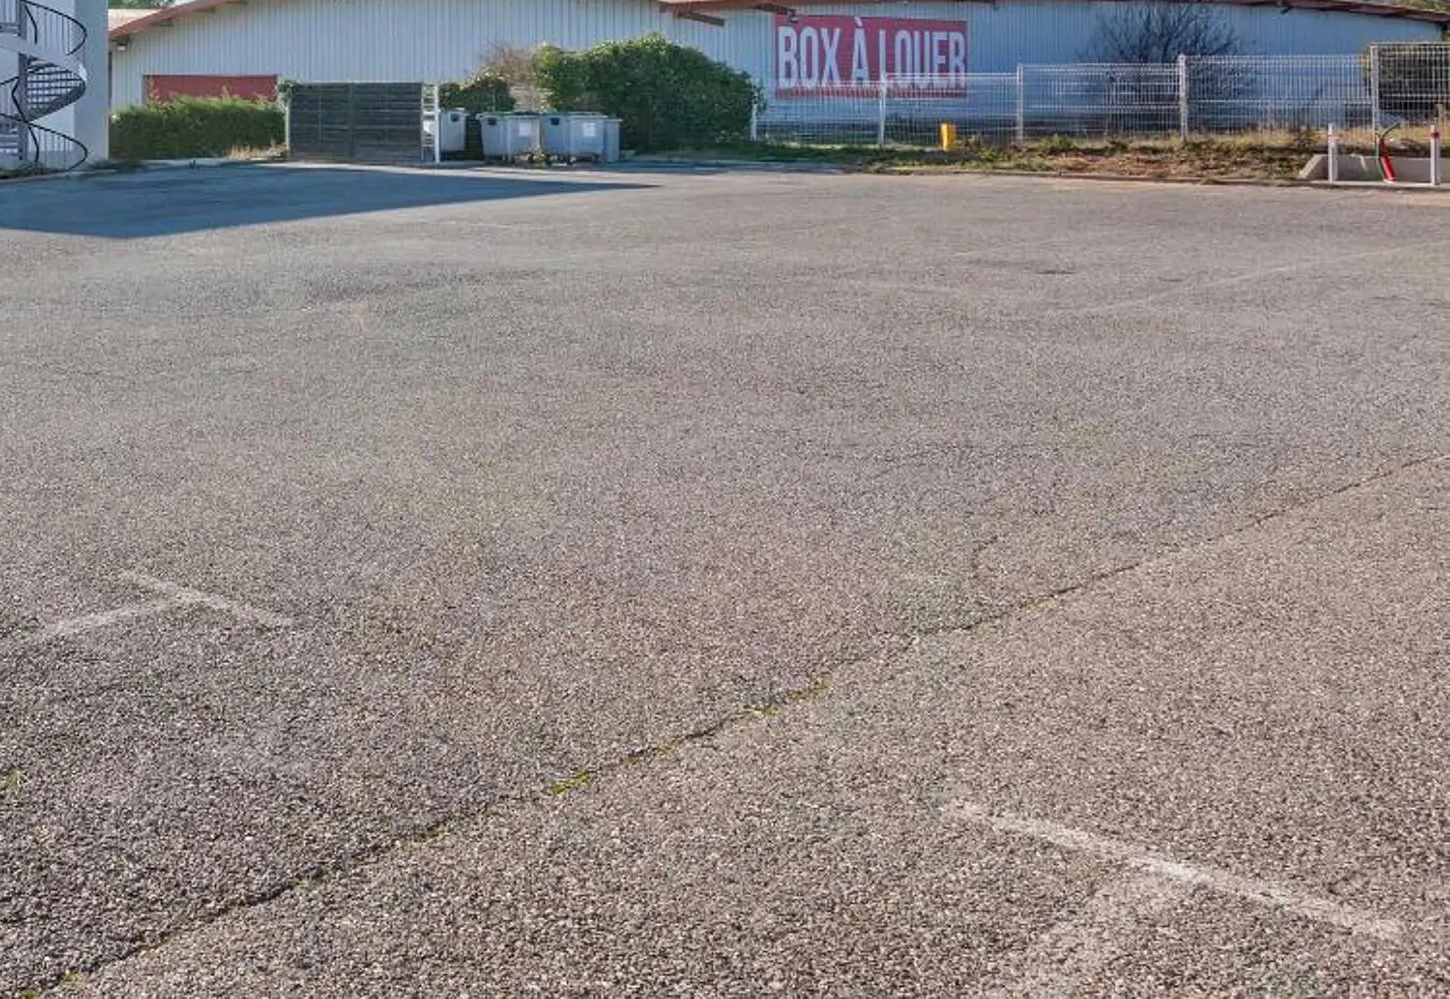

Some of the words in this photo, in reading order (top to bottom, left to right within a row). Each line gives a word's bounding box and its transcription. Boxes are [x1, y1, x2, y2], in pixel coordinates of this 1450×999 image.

[778, 26, 841, 89] BOX
[852, 16, 870, 88] À
[879, 29, 965, 89] LOUER
